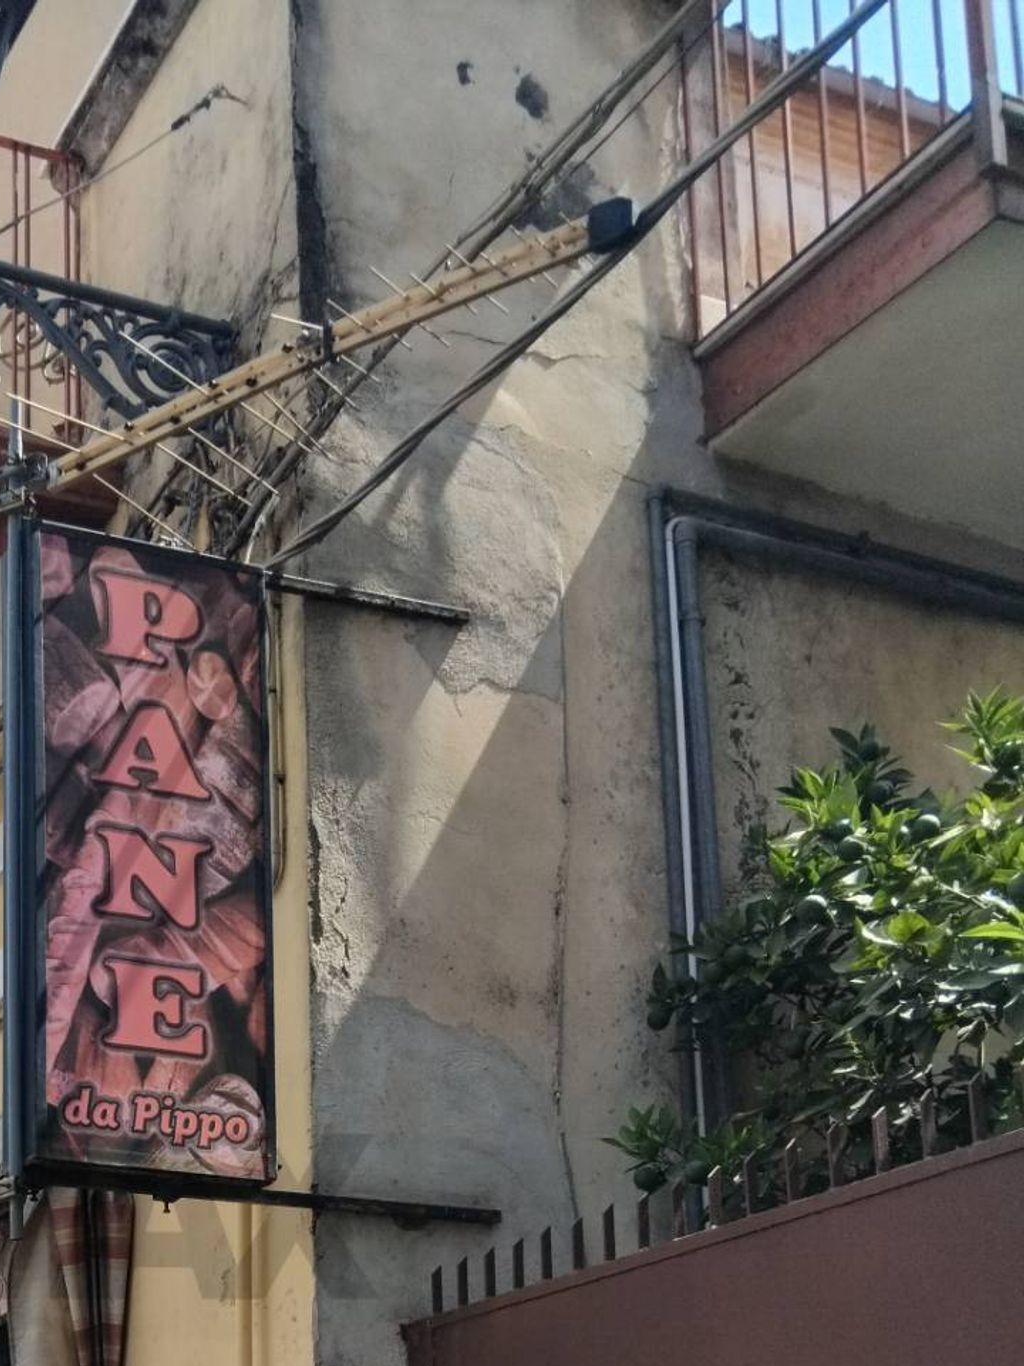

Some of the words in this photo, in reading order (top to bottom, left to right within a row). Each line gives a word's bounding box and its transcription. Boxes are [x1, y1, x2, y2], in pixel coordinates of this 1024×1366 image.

[94, 568, 212, 1058] PANE
[65, 1092, 119, 1131] da
[132, 1094, 251, 1149] Pippo
